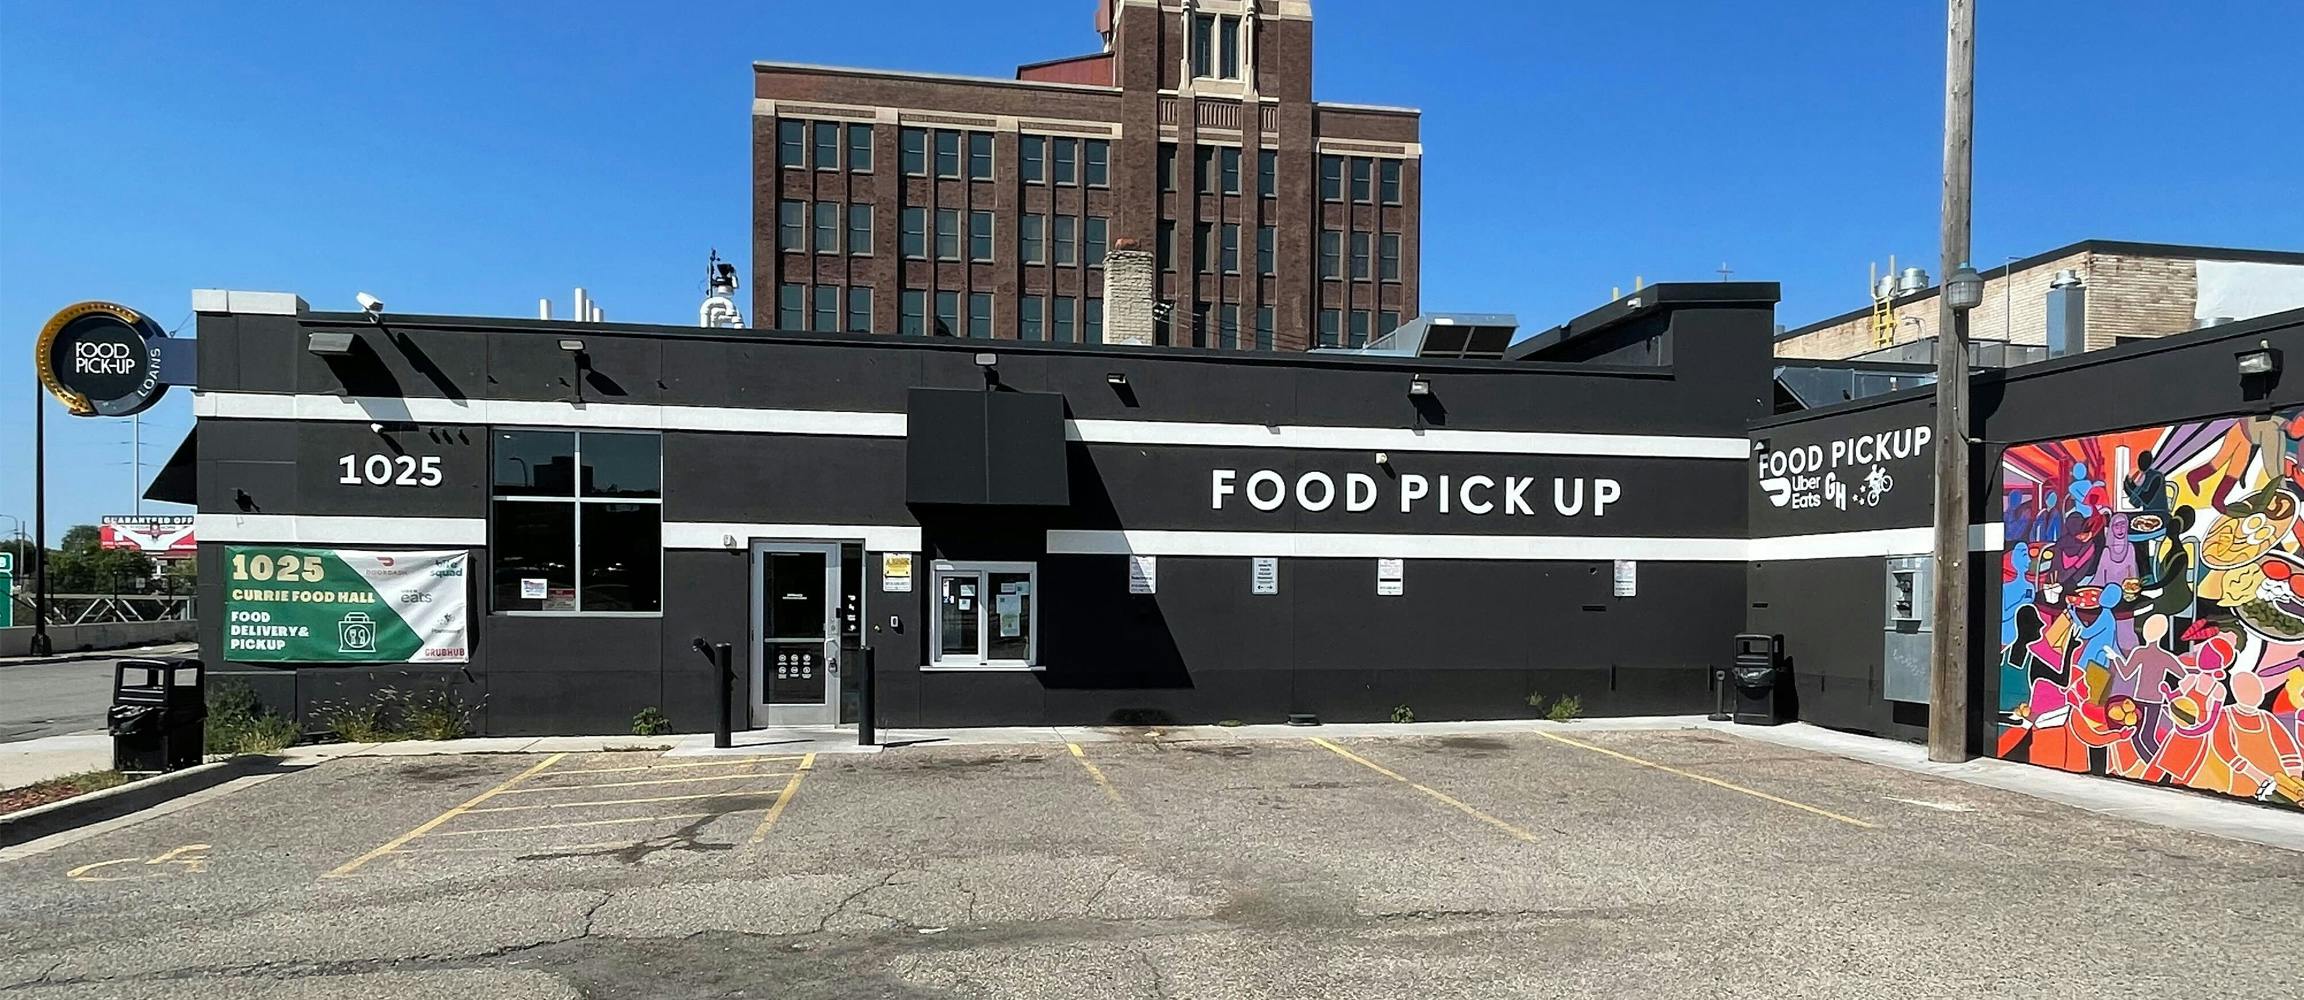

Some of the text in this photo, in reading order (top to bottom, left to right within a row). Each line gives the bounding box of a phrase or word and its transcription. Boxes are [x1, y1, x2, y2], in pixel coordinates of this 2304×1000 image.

[76, 342, 130, 358] FOOD
[76, 357, 135, 374] PICK-UP
[137, 348, 161, 397] LOANS
[1759, 426, 1932, 479] FOOD PICKUP
[339, 454, 443, 487] 1025
[1792, 475, 1822, 492] Uber
[1825, 471, 1847, 511] GH
[1212, 469, 1622, 517] FOOD PICK UP
[1792, 492, 1822, 510] Eats
[232, 554, 325, 582] 1025
[431, 567, 463, 578] squad
[232, 589, 375, 603] CURRIE FOOD HALL
[400, 592, 432, 603] eats
[231, 611, 271, 622] FOOD
[231, 624, 309, 637] DELIVERY&
[230, 638, 286, 650] PICKUP
[425, 648, 465, 656] GRUBHUB
